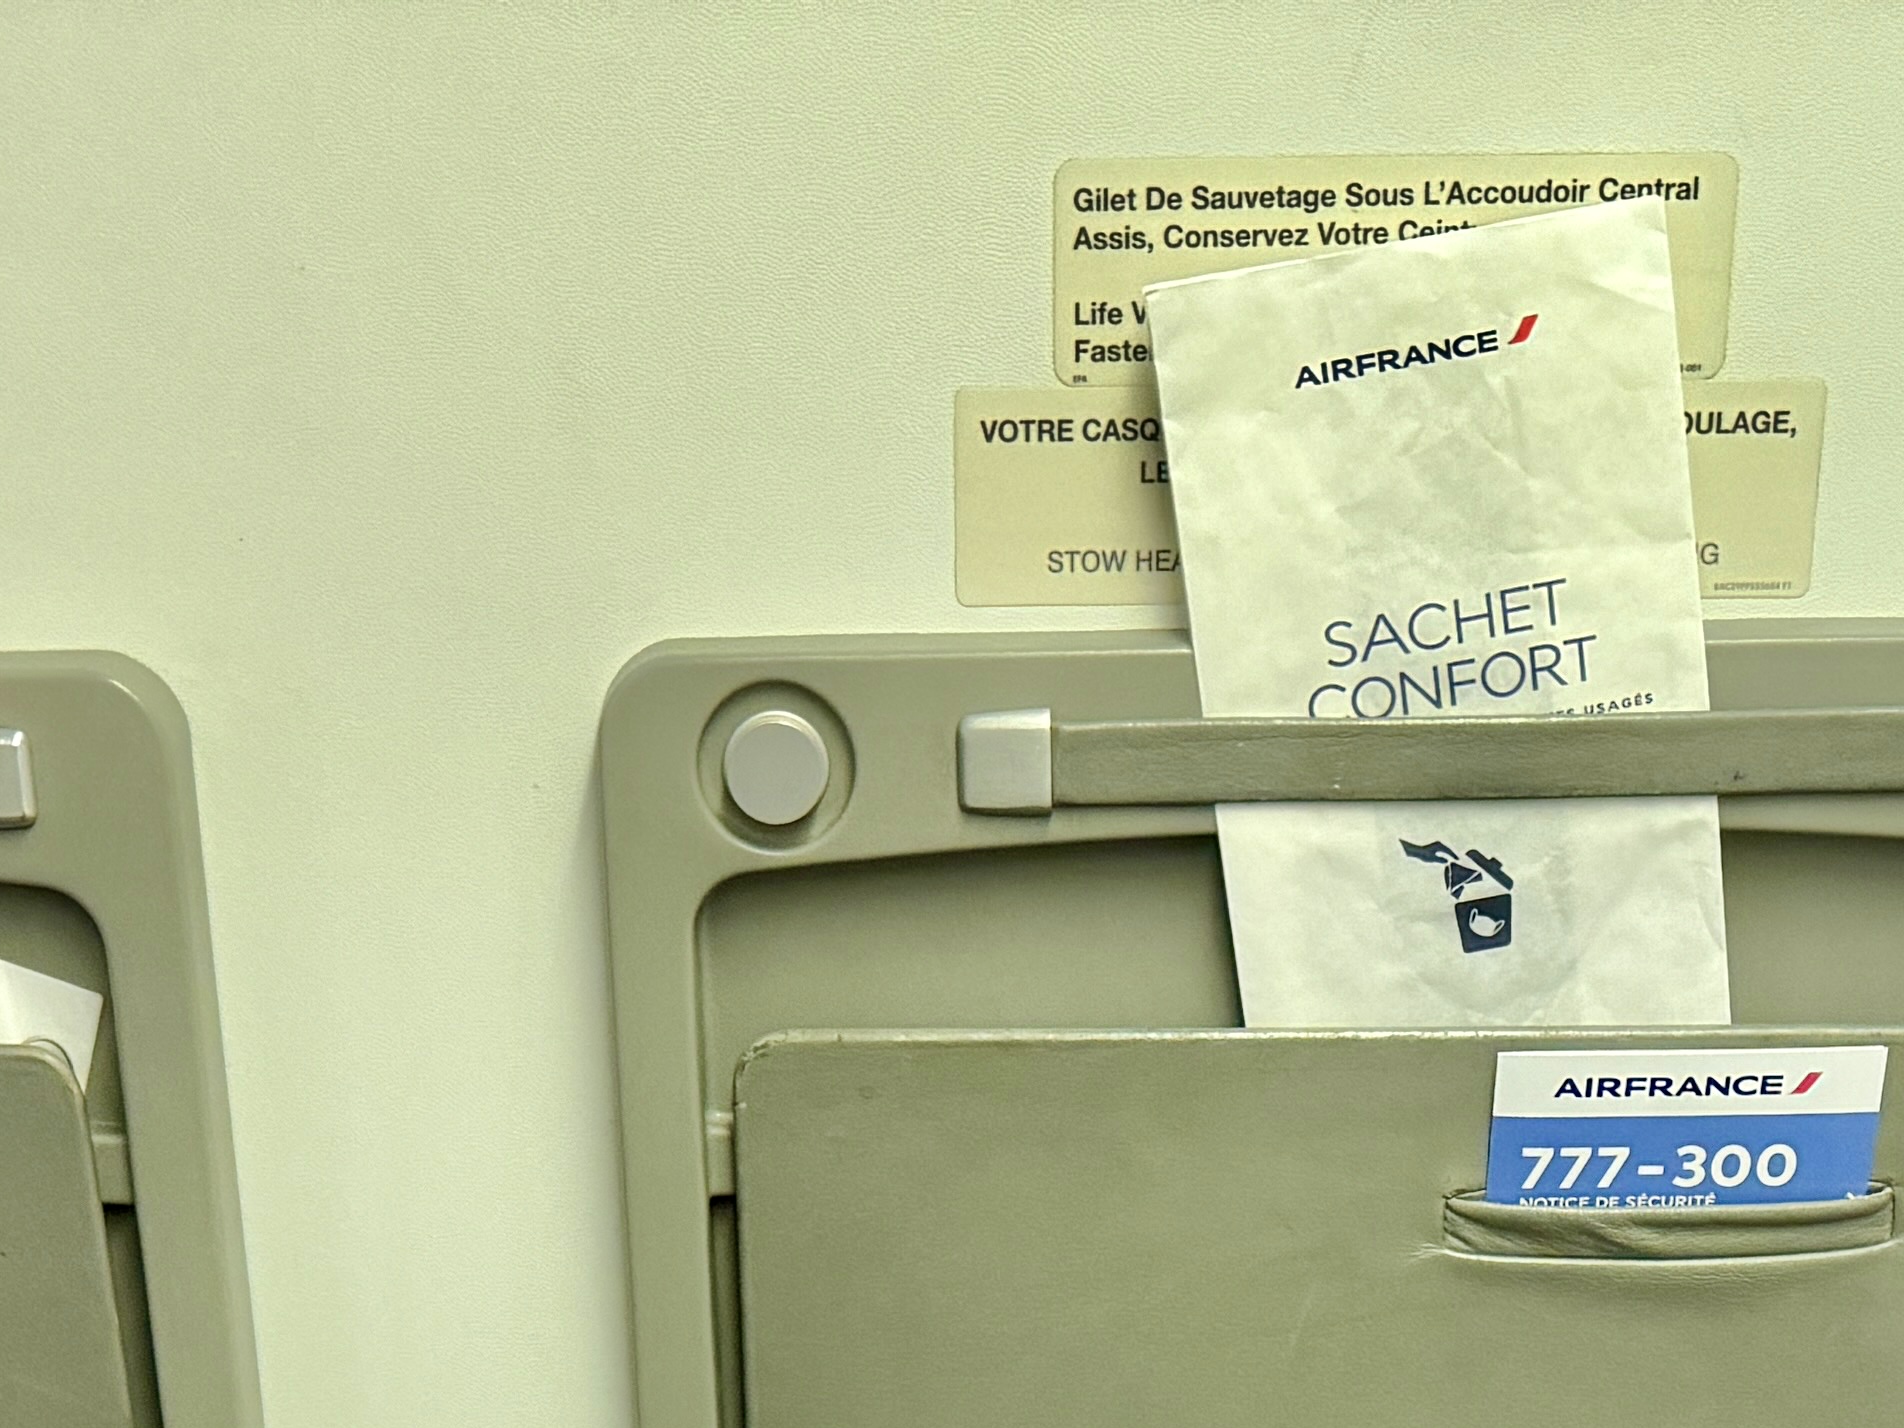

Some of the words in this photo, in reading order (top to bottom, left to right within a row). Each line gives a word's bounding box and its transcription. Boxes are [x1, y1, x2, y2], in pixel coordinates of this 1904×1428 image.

[1073, 187, 1138, 213] Gilet
[1145, 186, 1183, 211] De
[1190, 185, 1337, 213] Sauvetage
[1345, 182, 1415, 208] Sous
[1423, 178, 1591, 206] L'Accoudoir
[1598, 175, 1700, 203] Central
[1072, 224, 1154, 254] Assis,
[1163, 224, 1310, 249] Conservez
[1316, 221, 1390, 246] Votre
[1074, 301, 1124, 326] Life
[1295, 329, 1499, 388] AIRFRANCE
[979, 418, 1075, 444] VOTRE
[1082, 417, 1161, 443] CASQ
[1047, 549, 1128, 574] STOW
[1323, 577, 1567, 668] SACHET
[1308, 634, 1597, 718] CONFORT
[1553, 1074, 1785, 1099] AIRFRANCE
[1519, 1195, 1591, 1208] NOTICE
[1595, 1196, 1621, 1208] DE
[1625, 1192, 1718, 1208] SÉCURITÉ
